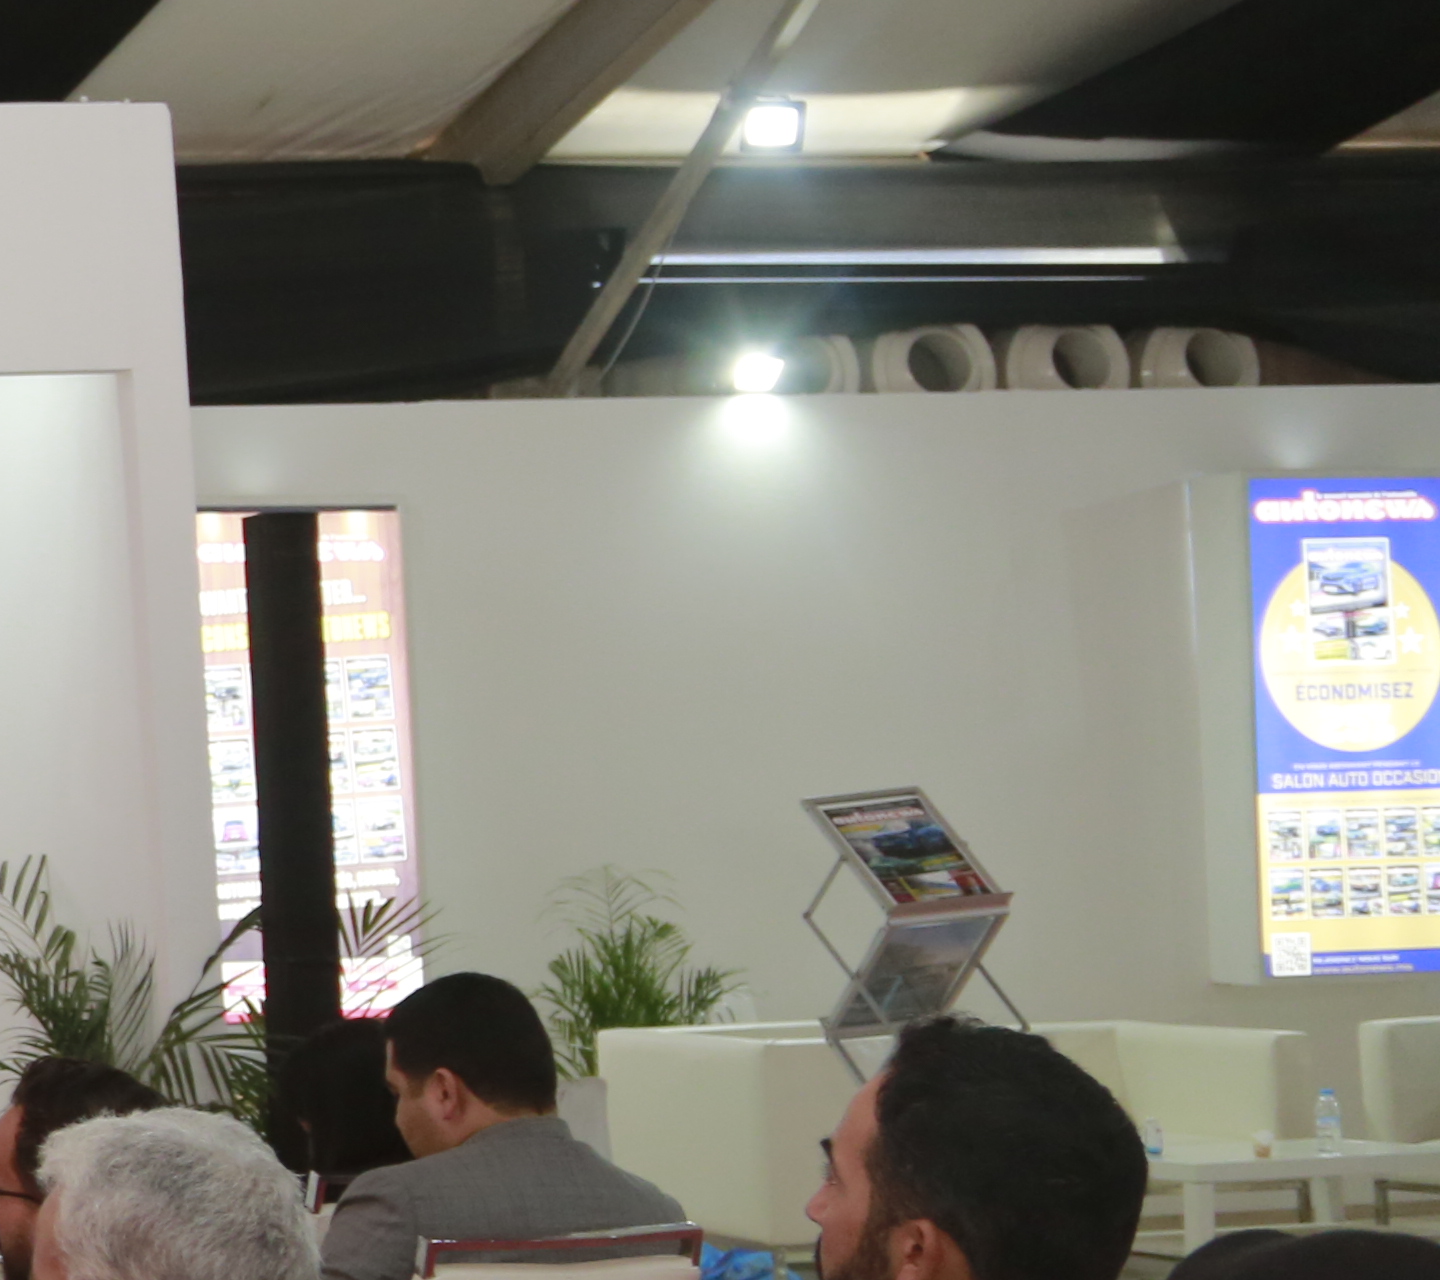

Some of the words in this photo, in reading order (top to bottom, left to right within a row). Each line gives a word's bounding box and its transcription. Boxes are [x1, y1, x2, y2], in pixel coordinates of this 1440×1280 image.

[1295, 680, 1415, 702] ÉCONOMISEZ
[1271, 772, 1325, 790] SALON
[1328, 770, 1369, 787] AUTO
[1373, 769, 1440, 786] OCCASIO
